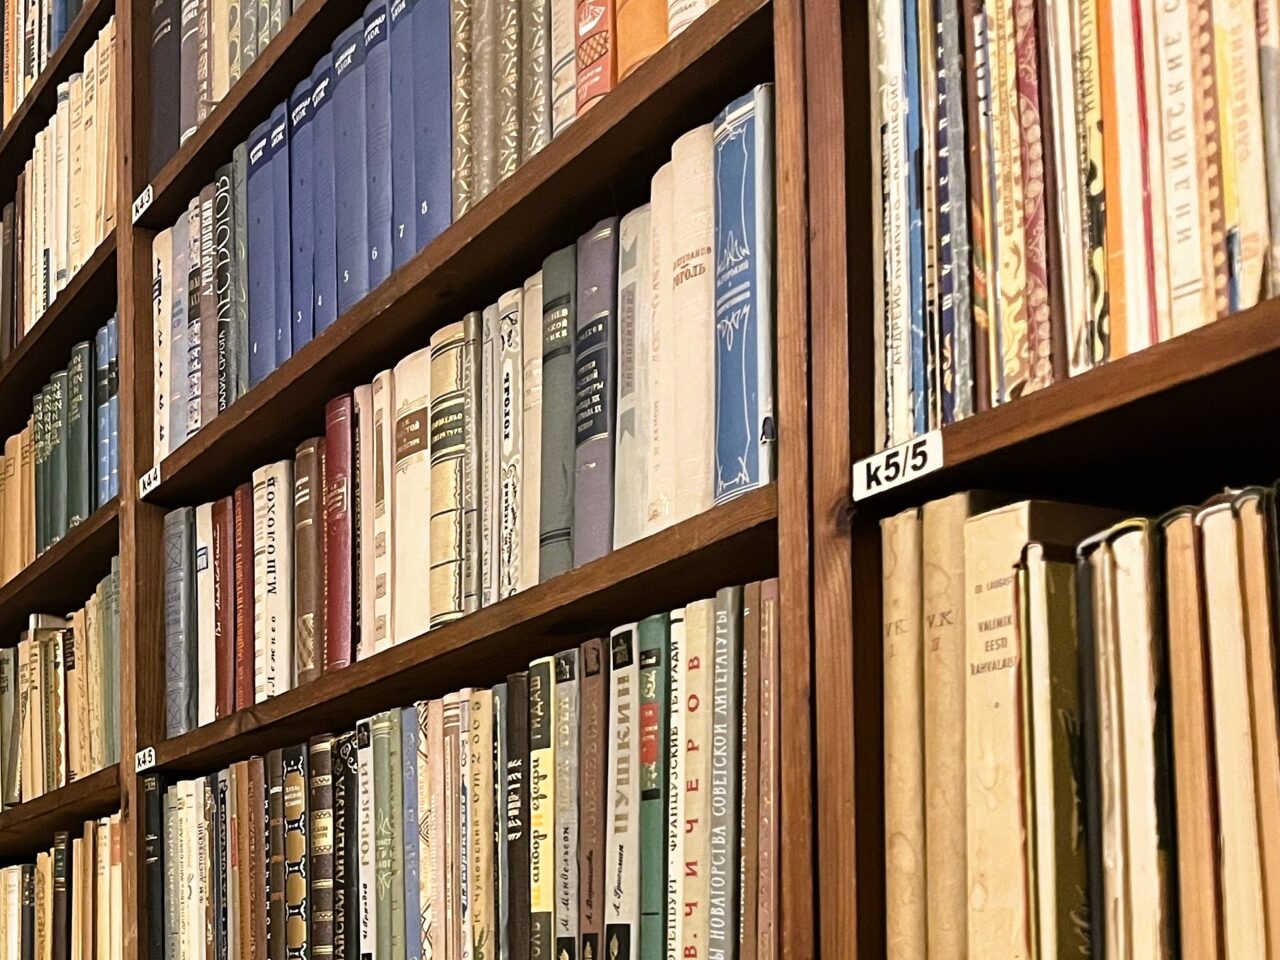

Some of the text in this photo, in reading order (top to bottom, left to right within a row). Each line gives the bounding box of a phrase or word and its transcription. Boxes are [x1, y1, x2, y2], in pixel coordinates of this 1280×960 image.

[865, 440, 929, 490] k5/5
[713, 609, 728, 716] ЛИТЕРАТУРЫ
[984, 637, 1008, 653] EESTI
[613, 674, 631, 836] ПУШКИН
[683, 655, 701, 959] В. ЧИЧЕРОВ
[712, 722, 728, 818] СОВЕТСКОЙ
[333, 774, 345, 884] ЛИТЕРАТУРА
[709, 824, 727, 941] НОВАТОРСТВА
